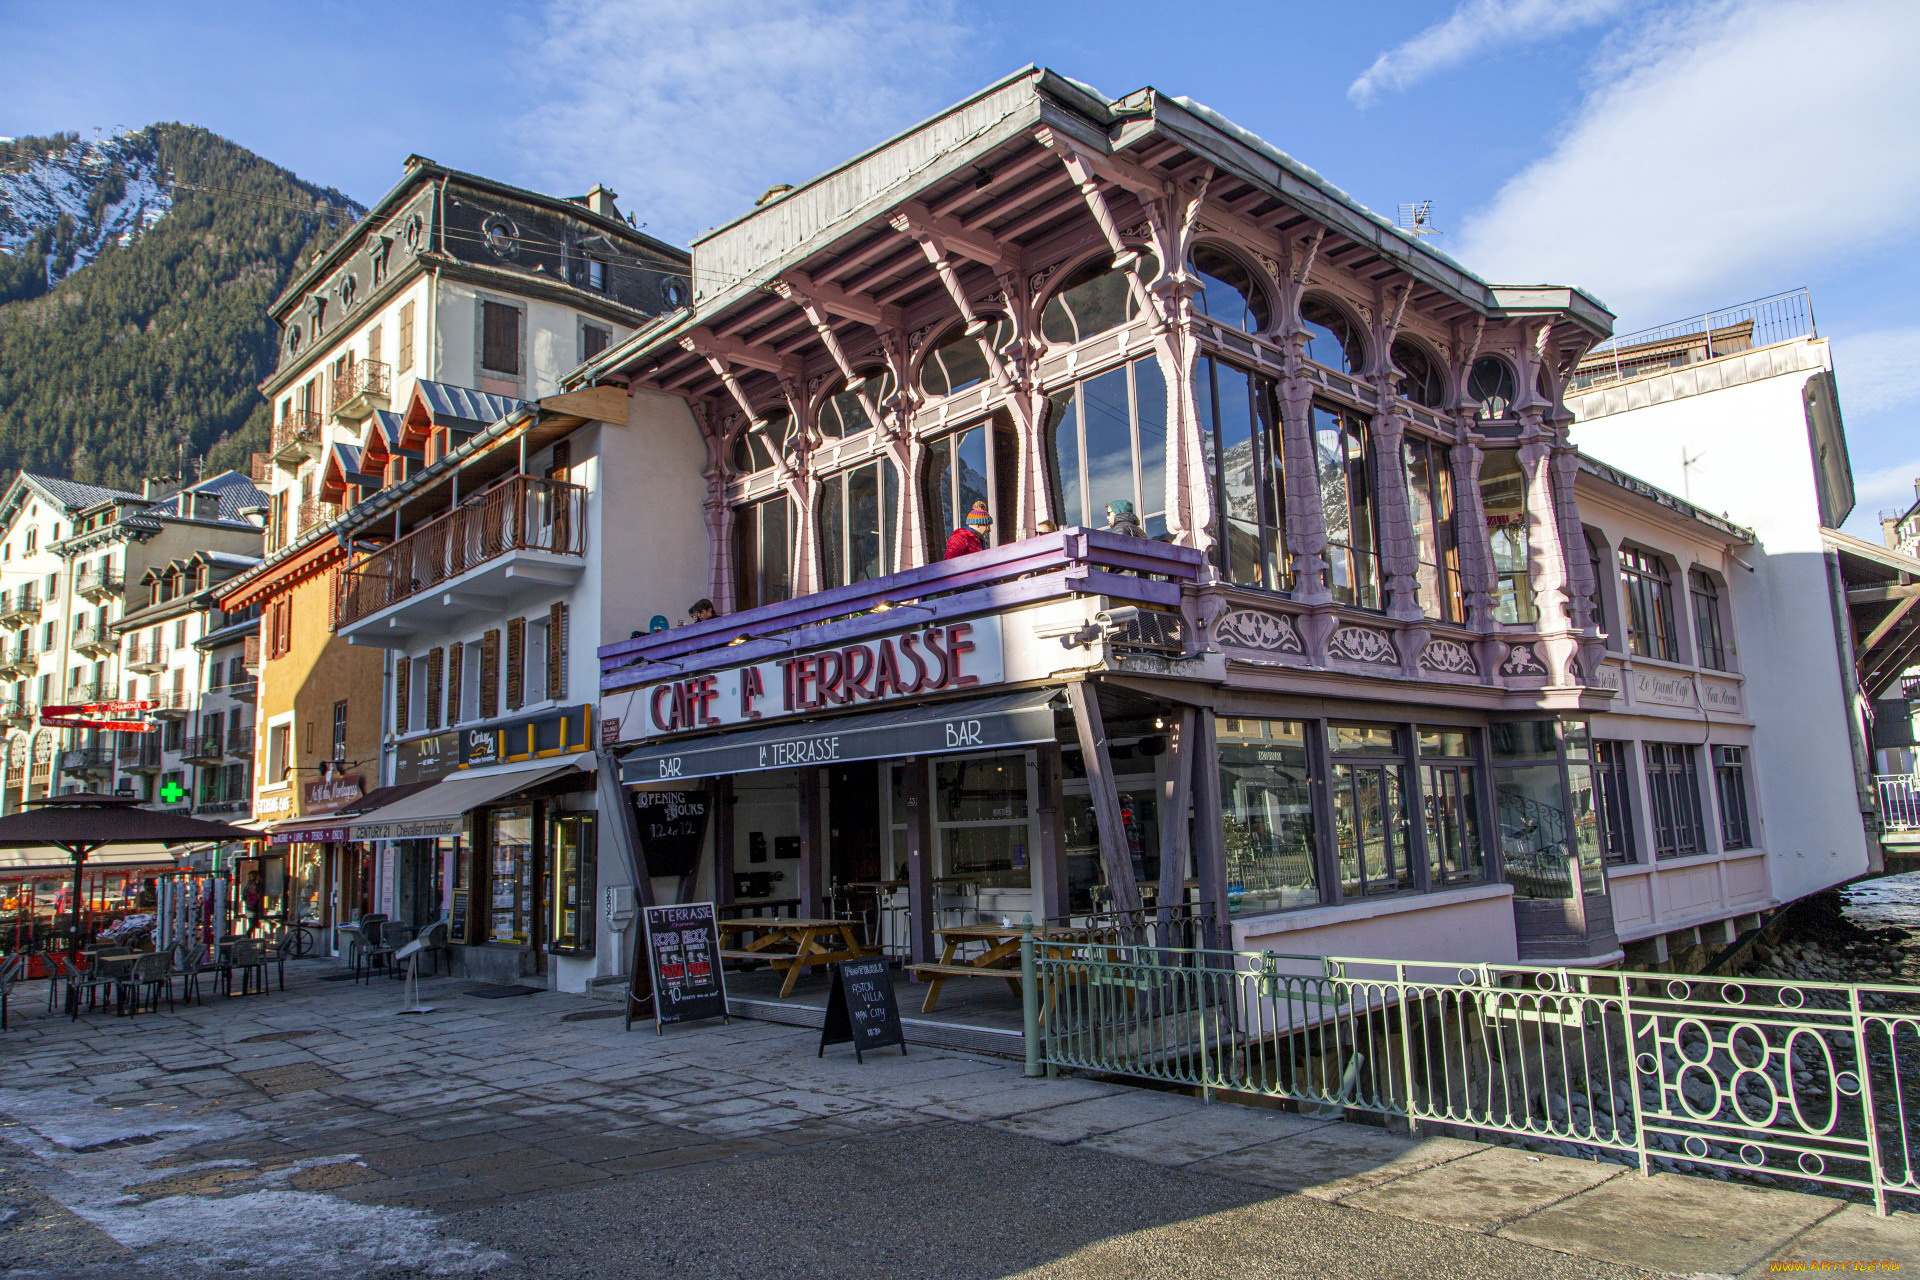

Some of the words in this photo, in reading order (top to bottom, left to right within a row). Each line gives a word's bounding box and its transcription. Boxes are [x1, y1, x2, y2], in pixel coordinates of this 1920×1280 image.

[651, 675, 720, 731] CAFE
[740, 666, 764, 718] LA
[776, 623, 980, 711] TERRASSE
[945, 720, 983, 747] BAR
[772, 737, 839, 765] TERRASSE
[659, 757, 682, 778] BAR
[637, 792, 685, 808] OPENING
[356, 826, 383, 839] CENTURY
[384, 825, 391, 838] 21
[659, 906, 713, 922] TERRASSE
[852, 981, 874, 996] ASTON
[862, 991, 884, 1002] VILLA
[1638, 1015, 1838, 1137] 1880
